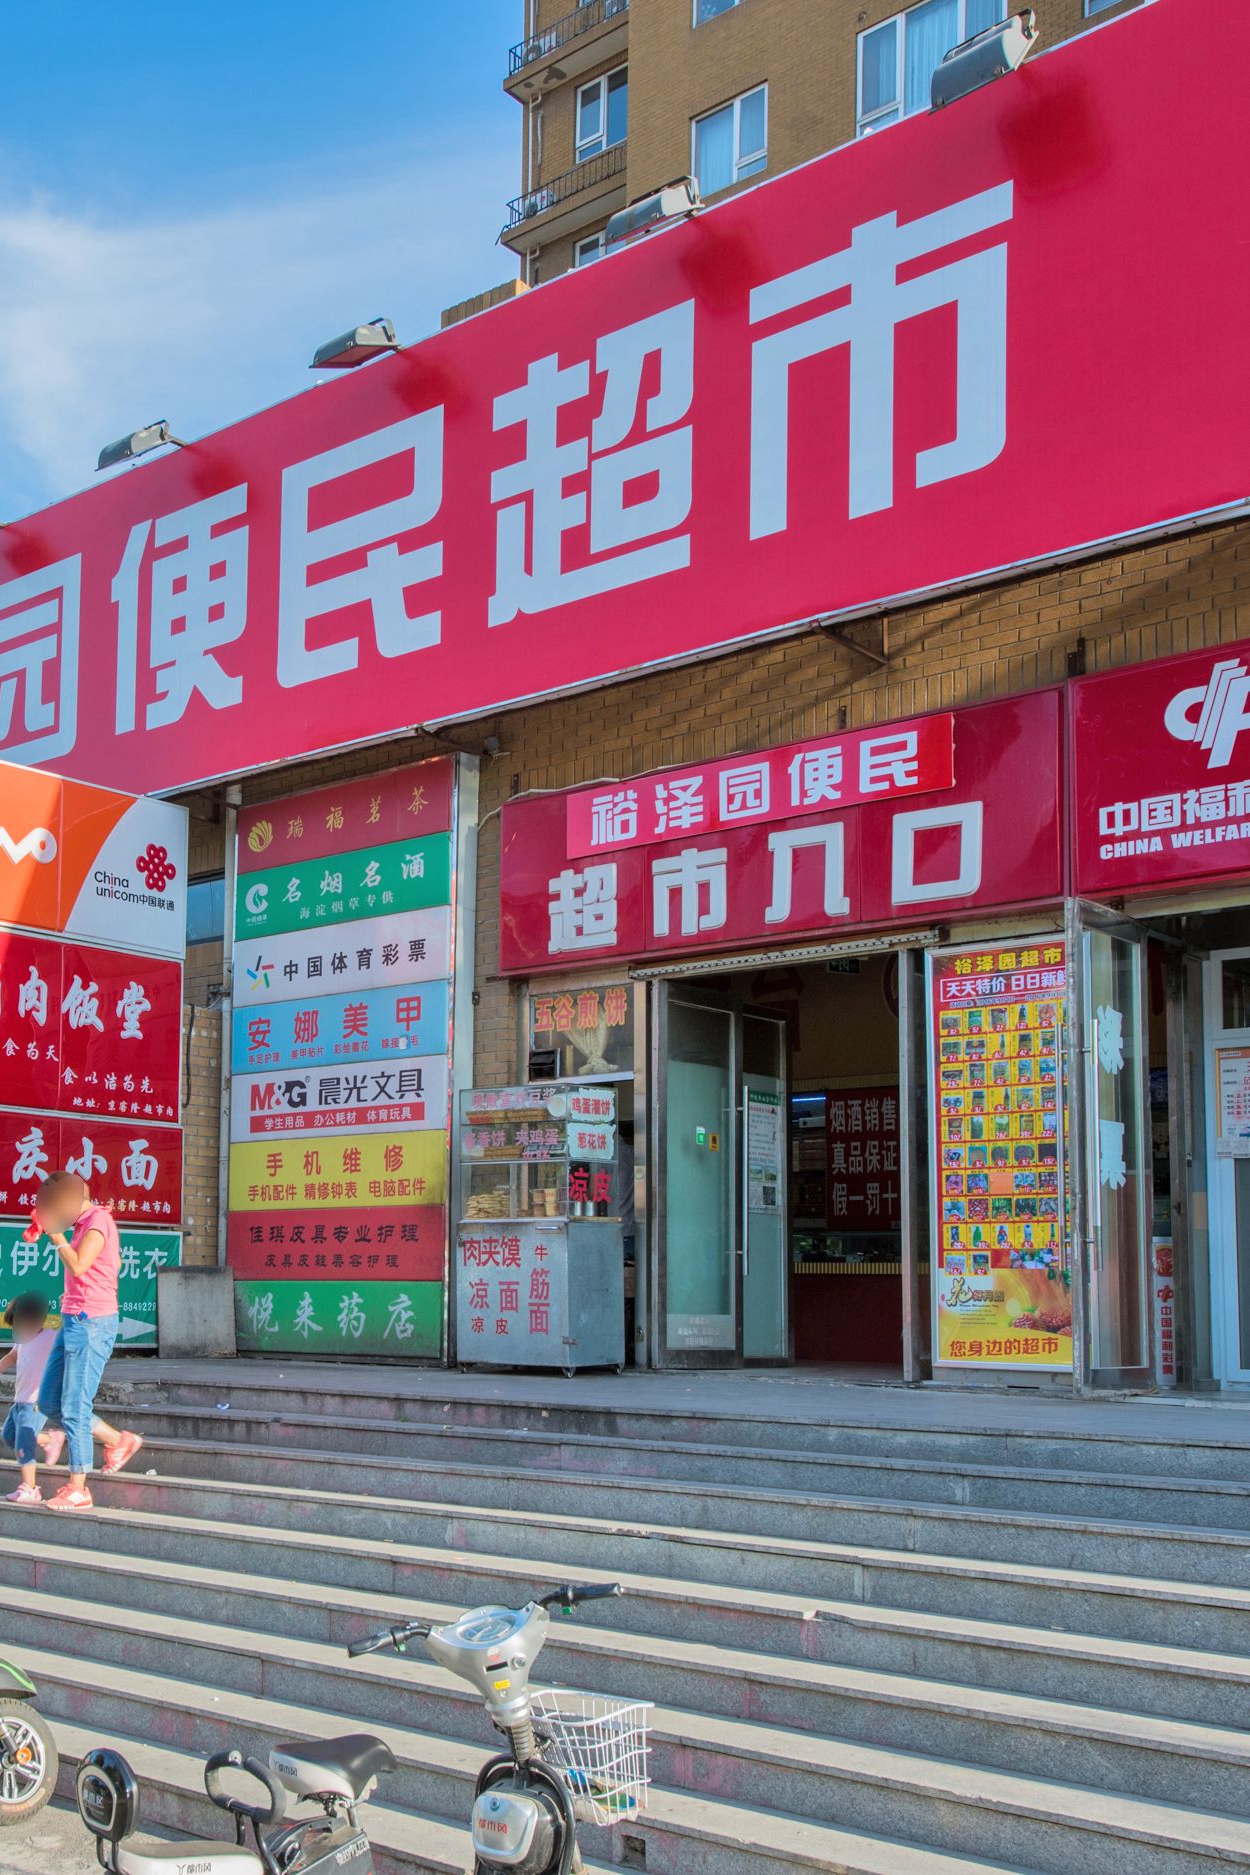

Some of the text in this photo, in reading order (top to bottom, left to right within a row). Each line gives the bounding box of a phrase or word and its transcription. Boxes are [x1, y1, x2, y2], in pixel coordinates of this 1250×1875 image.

[591, 729, 919, 847] 裕泽园便民
[286, 786, 429, 839] 瑞福茗茶
[1099, 836, 1164, 860] CHINA
[94, 871, 130, 889] China
[282, 852, 425, 903] 名烟名酒
[548, 800, 984, 955] 超市入口
[139, 894, 175, 912] 中国联通
[283, 939, 427, 982] 中国体育彩票
[954, 947, 1063, 975] 裕泽园超市
[946, 976, 1007, 998] 天天特价
[247, 996, 422, 1051] 安娜美甲
[534, 986, 628, 1033] 五谷煎饼
[61, 1066, 154, 1093] 食以洁为先
[318, 1068, 425, 1107] 晨光文具
[264, 1107, 412, 1130] 学生用品 办公耗材 体育玩具
[571, 1097, 611, 1116] 鸡蛋灌饼
[830, 1096, 897, 1134] 烟酒销售
[515, 1128, 559, 1147] 夹鸡蛋
[577, 1132, 607, 1150] 葱花饼
[266, 1145, 404, 1178] 手机维修
[831, 1140, 898, 1175] 真品保证
[248, 1178, 427, 1202] 手机配件 精修钟表 电脑配件
[568, 1166, 613, 1204] 凉皮
[832, 1181, 898, 1217] 假一罚十
[249, 1224, 420, 1245] 佳琪皮具专业护理
[462, 1235, 522, 1268] 肉夹馍
[469, 1279, 520, 1314] 凉面
[528, 1243, 550, 1336] 牛筋面
[247, 1291, 417, 1340] 悦来药店
[470, 1315, 509, 1335] 凉皮
[949, 1336, 1059, 1358] 您身边的超市
